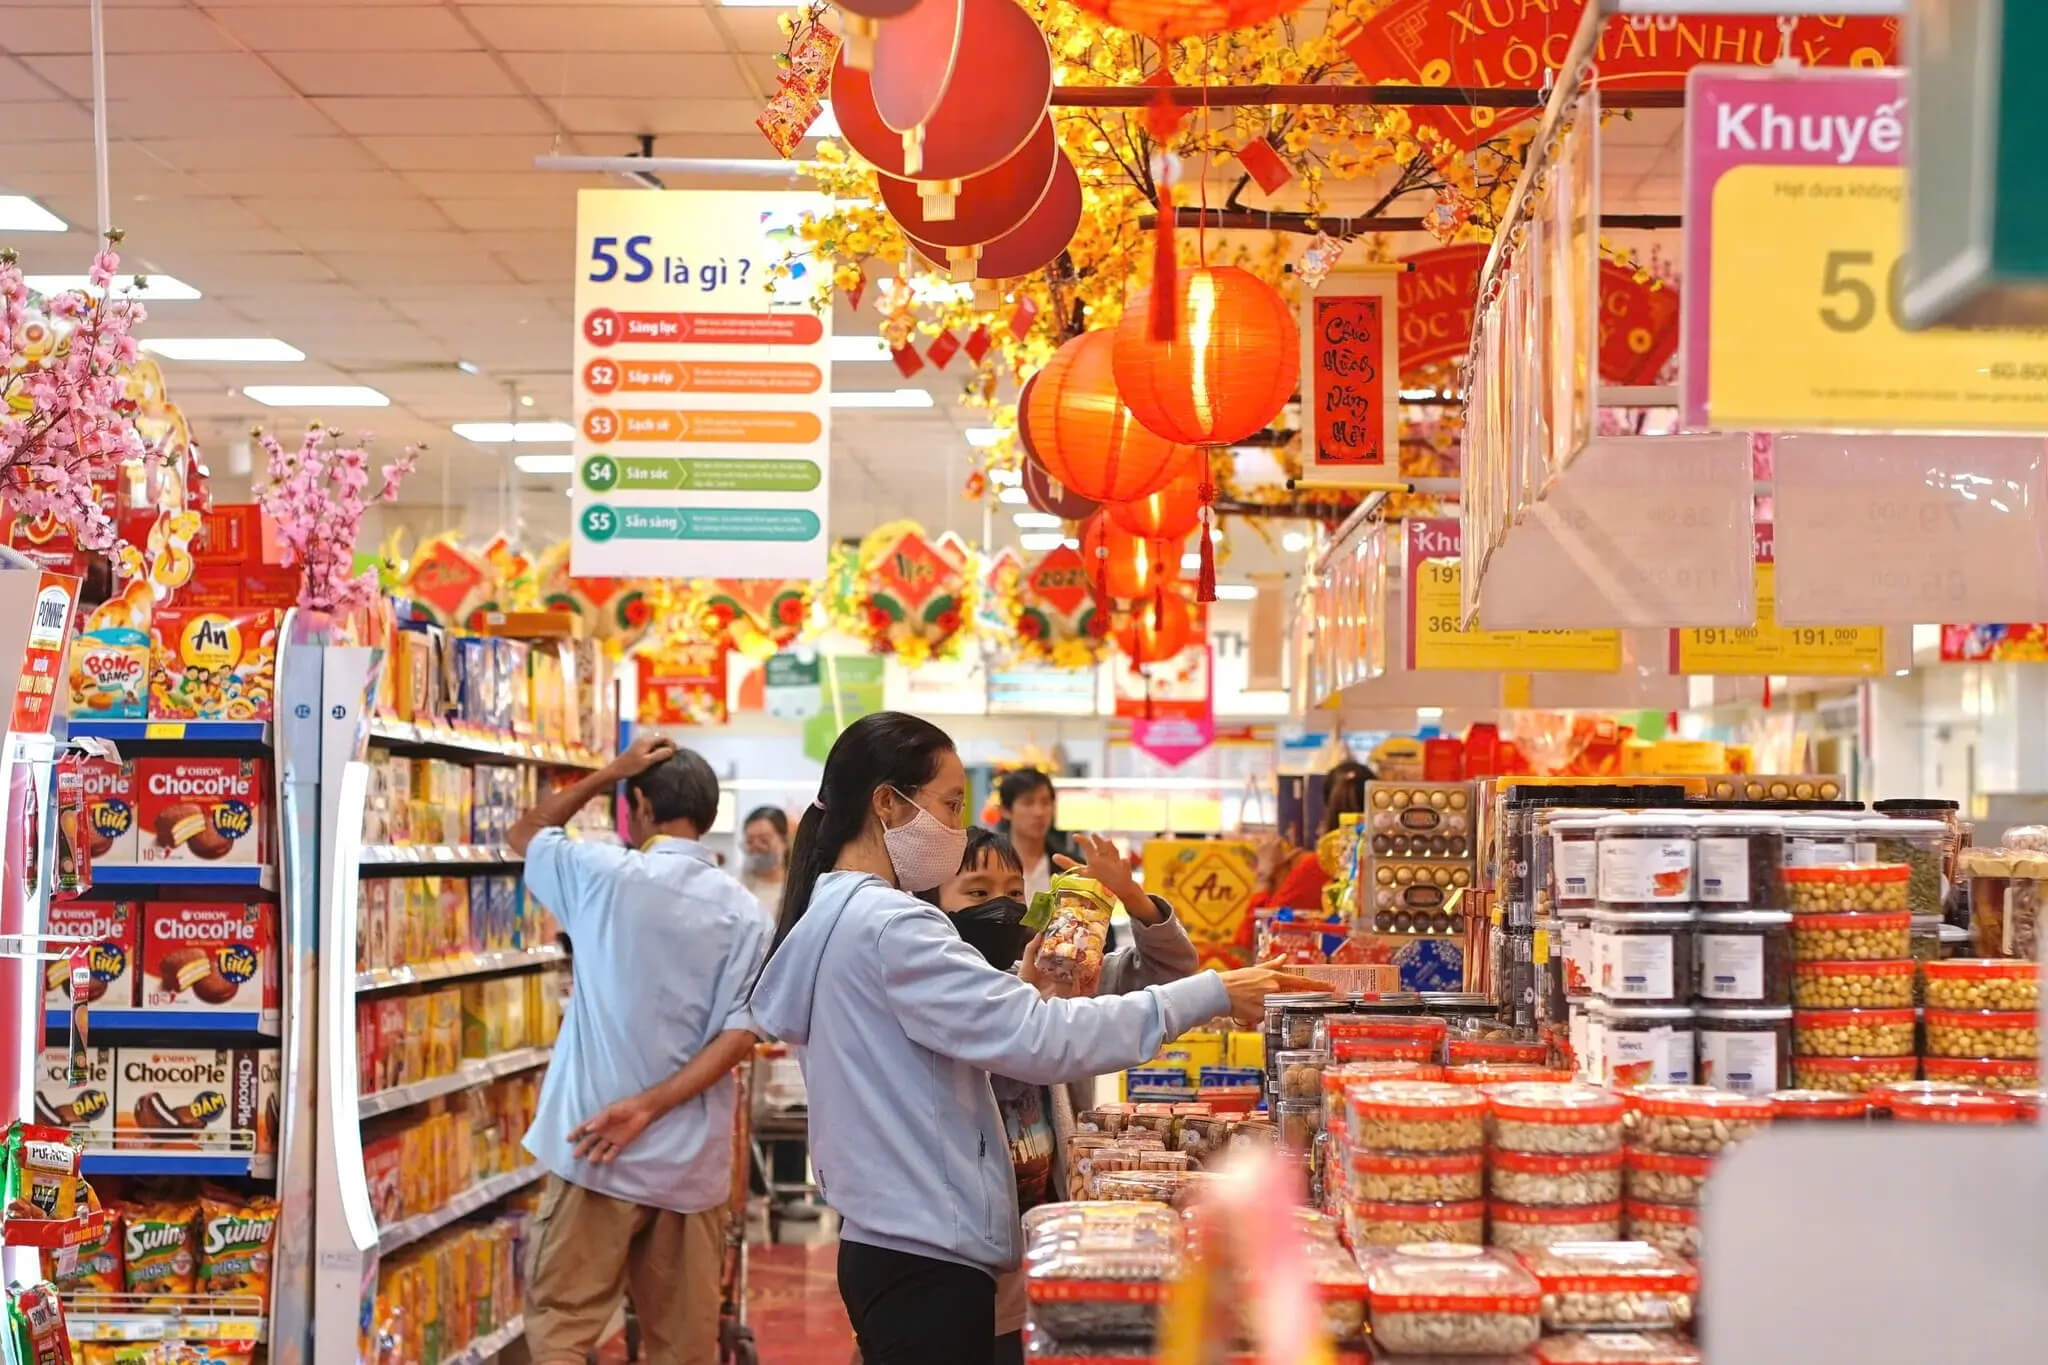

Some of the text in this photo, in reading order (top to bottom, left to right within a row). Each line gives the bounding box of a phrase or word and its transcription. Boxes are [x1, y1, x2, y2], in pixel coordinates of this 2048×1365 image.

[1474, 34, 1568, 88] LỘC
[589, 235, 751, 292] 5S là gì ?
[591, 317, 613, 337] S1
[590, 366, 613, 385] S2
[590, 417, 612, 435] S3
[589, 463, 612, 481] S4
[588, 513, 611, 531] S5
[191, 620, 228, 651] An
[84, 774, 130, 795] oPie
[149, 774, 250, 796] ChocoPie
[154, 919, 255, 940] ChocoPie
[124, 1062, 226, 1083] ChocoPie
[238, 1059, 253, 1127] ChocoPie
[126, 1223, 187, 1261] Swing
[203, 1215, 273, 1254] Swing
